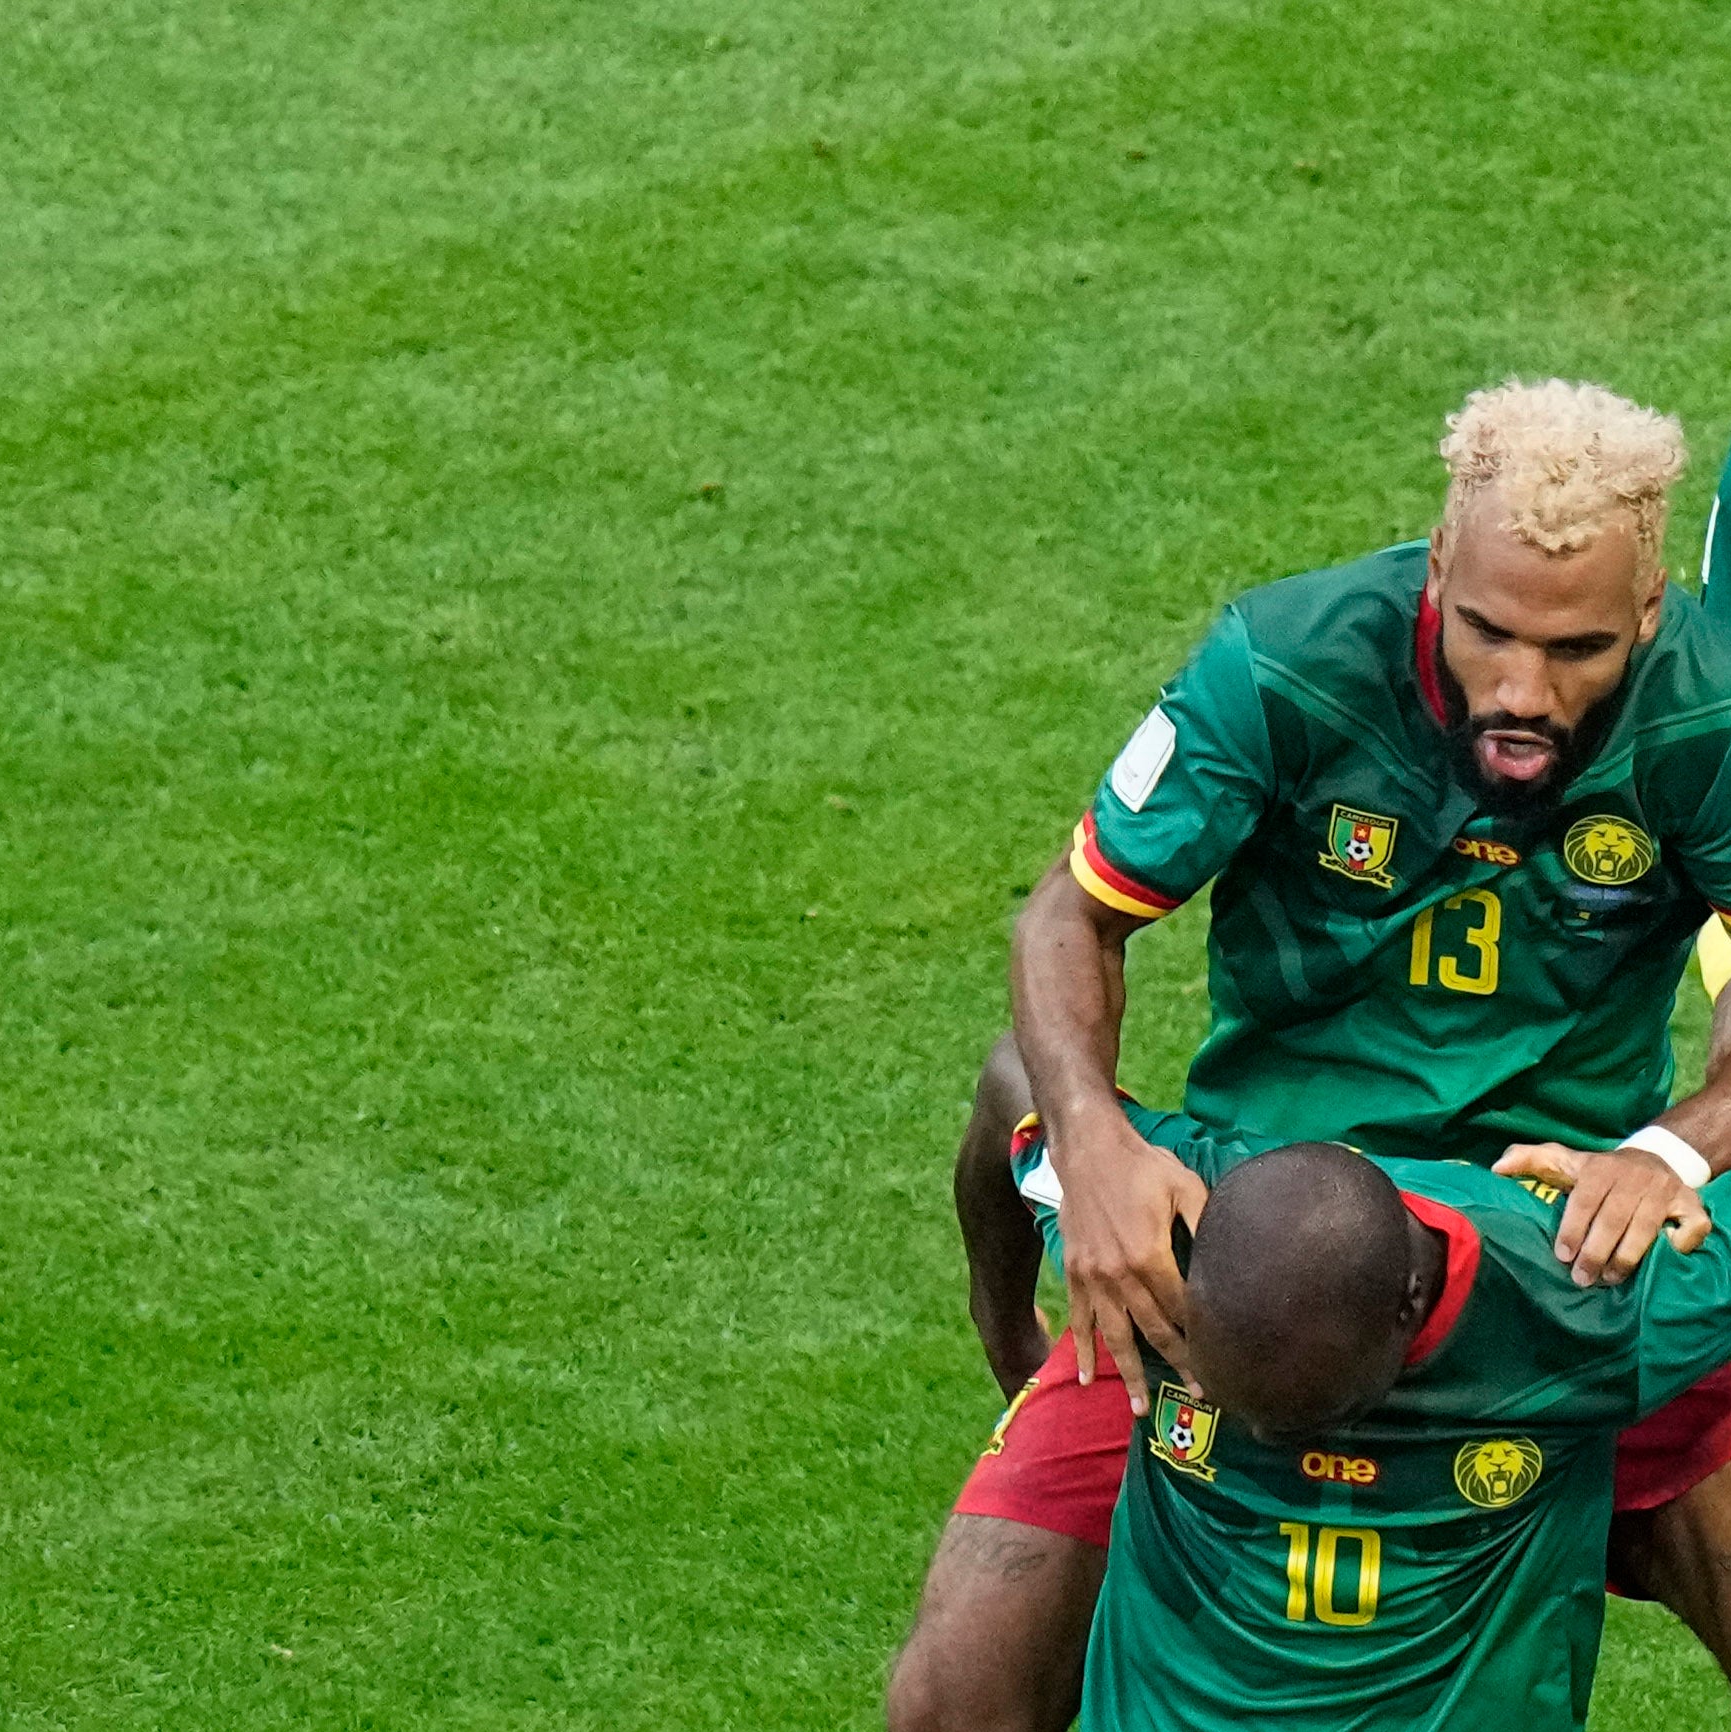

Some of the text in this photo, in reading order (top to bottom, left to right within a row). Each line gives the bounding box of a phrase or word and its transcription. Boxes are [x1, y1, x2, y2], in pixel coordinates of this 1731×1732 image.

[1454, 837, 1520, 867] one
[1409, 887, 1502, 996] 13
[1301, 1451, 1377, 1483] one
[1278, 1521, 1381, 1627] 10
